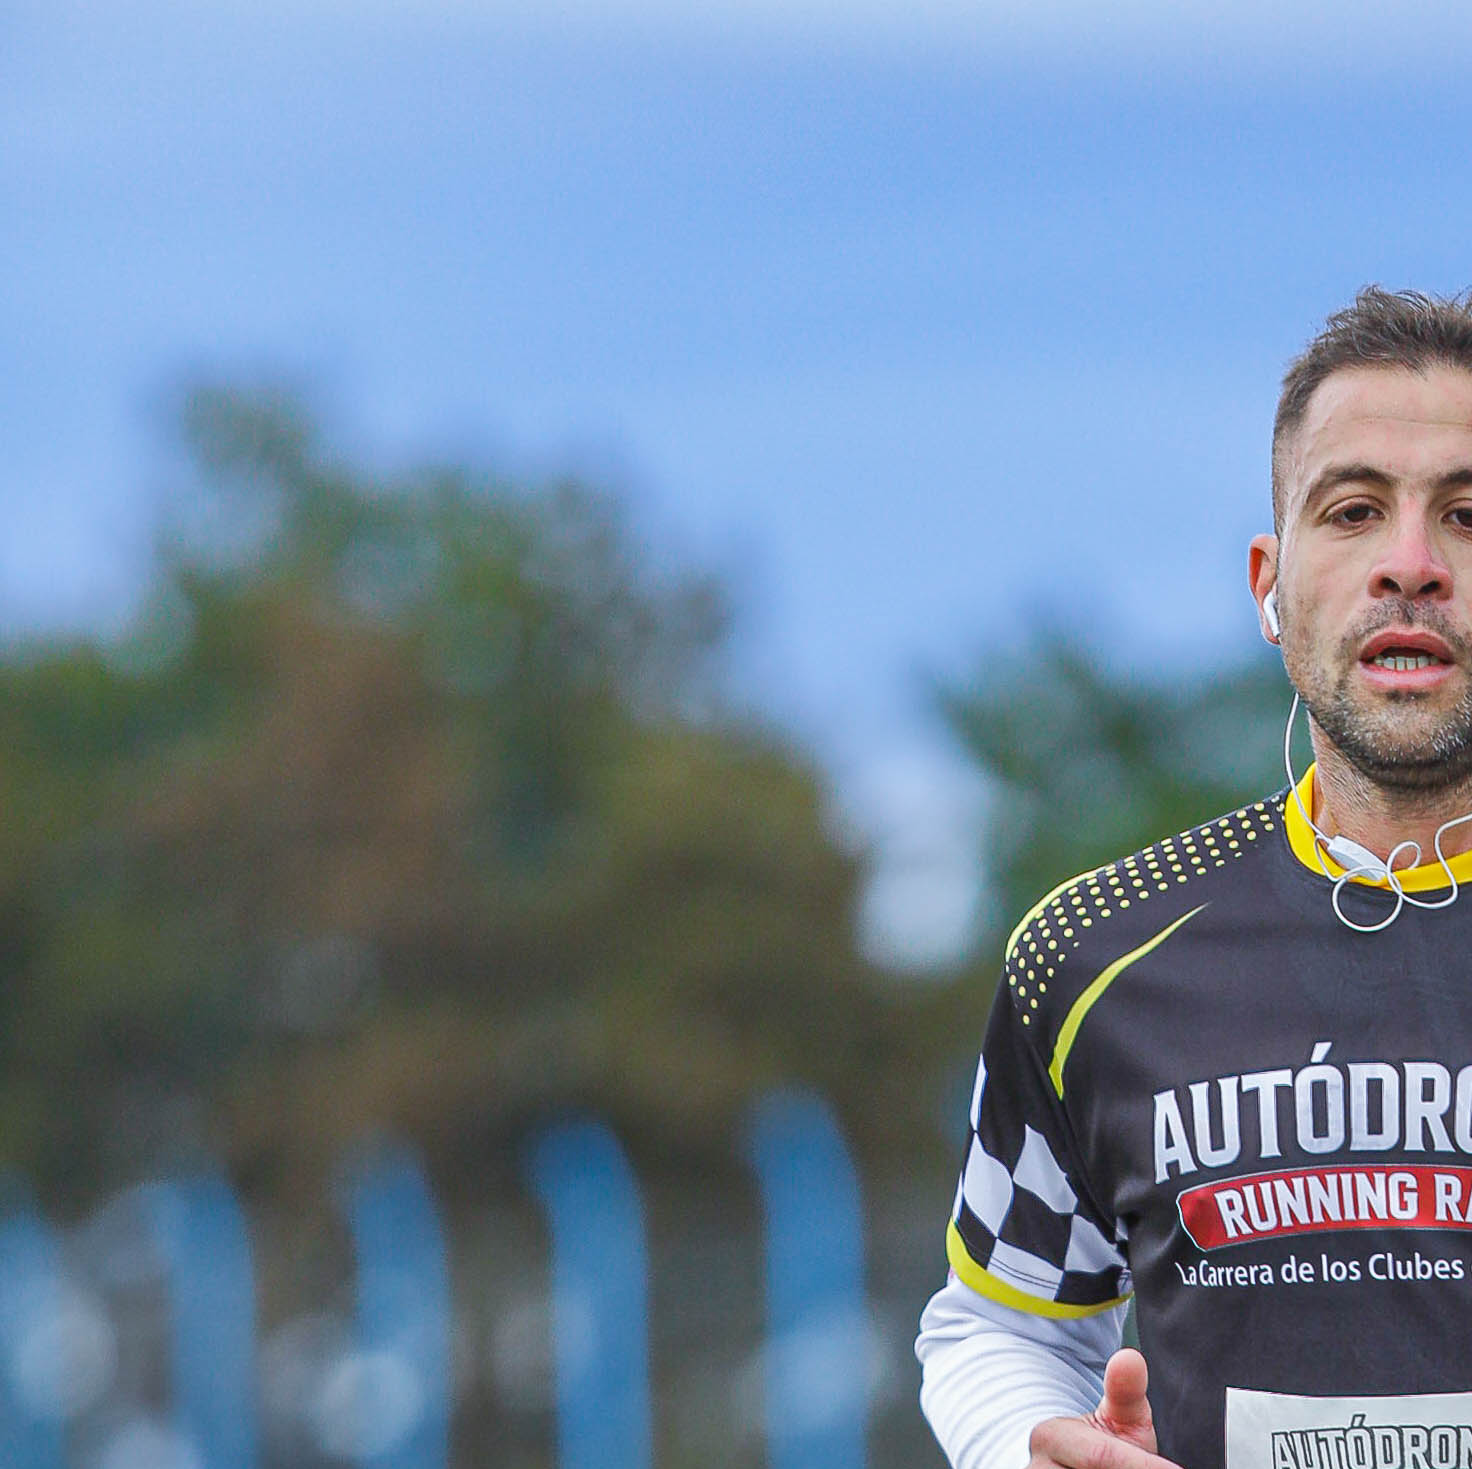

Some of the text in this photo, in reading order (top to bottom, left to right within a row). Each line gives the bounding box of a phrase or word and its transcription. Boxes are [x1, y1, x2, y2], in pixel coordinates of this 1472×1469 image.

[1213, 1170, 1419, 1239] RUNNING
[1174, 1261, 1198, 1287] La
[1199, 1259, 1275, 1287] Carrera
[1280, 1253, 1315, 1284] de
[1321, 1253, 1361, 1283] los
[1368, 1252, 1465, 1281] Clubes
